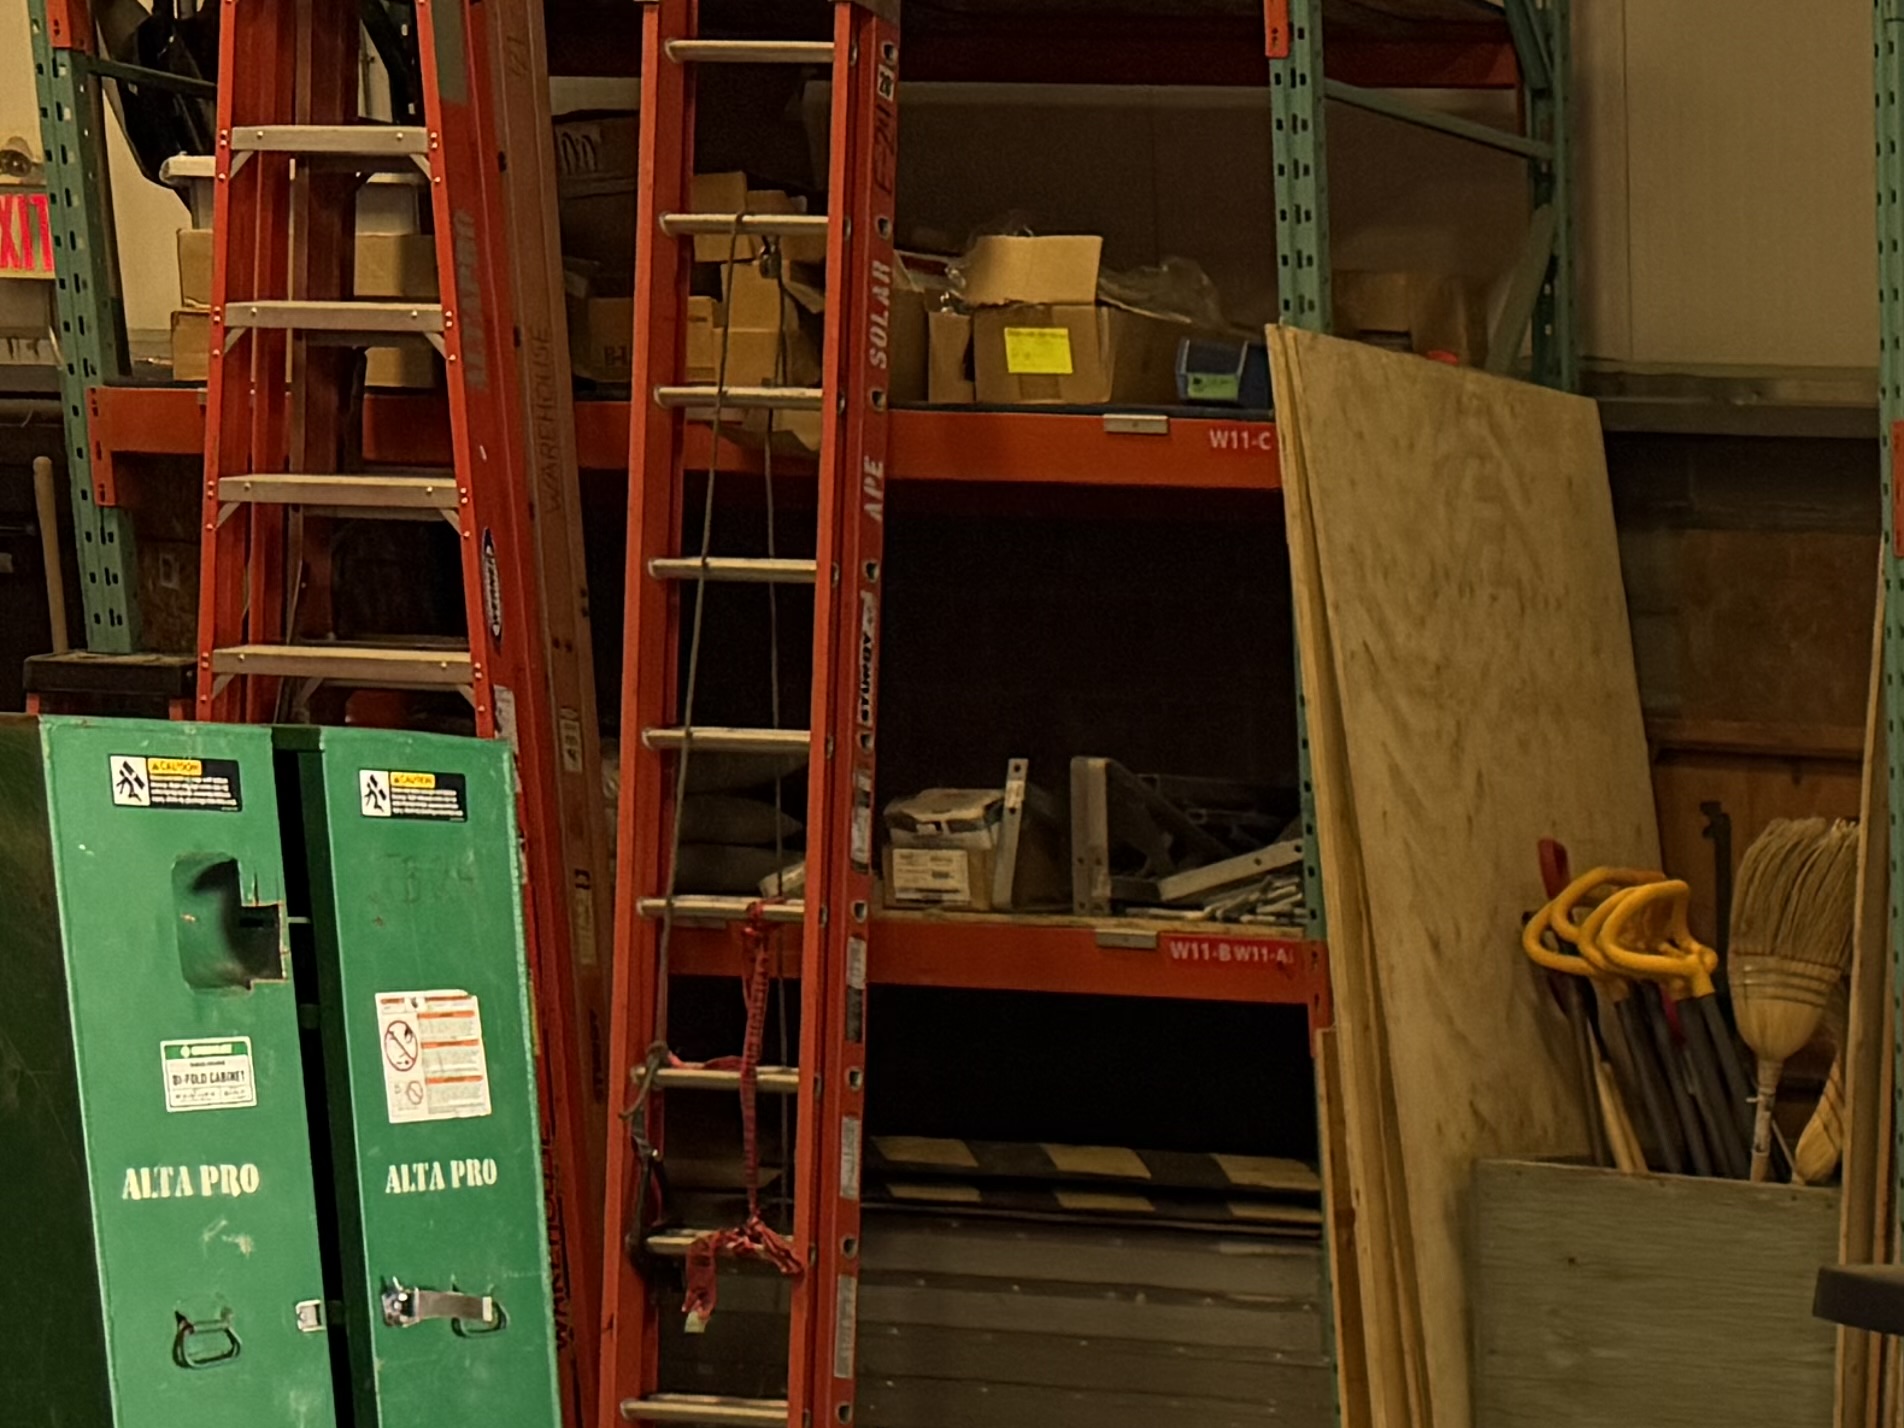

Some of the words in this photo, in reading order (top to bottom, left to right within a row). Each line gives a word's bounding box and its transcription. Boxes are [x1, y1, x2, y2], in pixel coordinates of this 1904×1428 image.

[870, 260, 893, 370] SOLAR
[1209, 428, 1272, 451] W11-C
[863, 455, 885, 523] APE
[1169, 940, 1232, 962] W11-B
[121, 1165, 195, 1200] ALTA
[200, 1163, 260, 1198] PRO
[385, 1161, 446, 1195] ALTA
[450, 1158, 498, 1189] PRO
